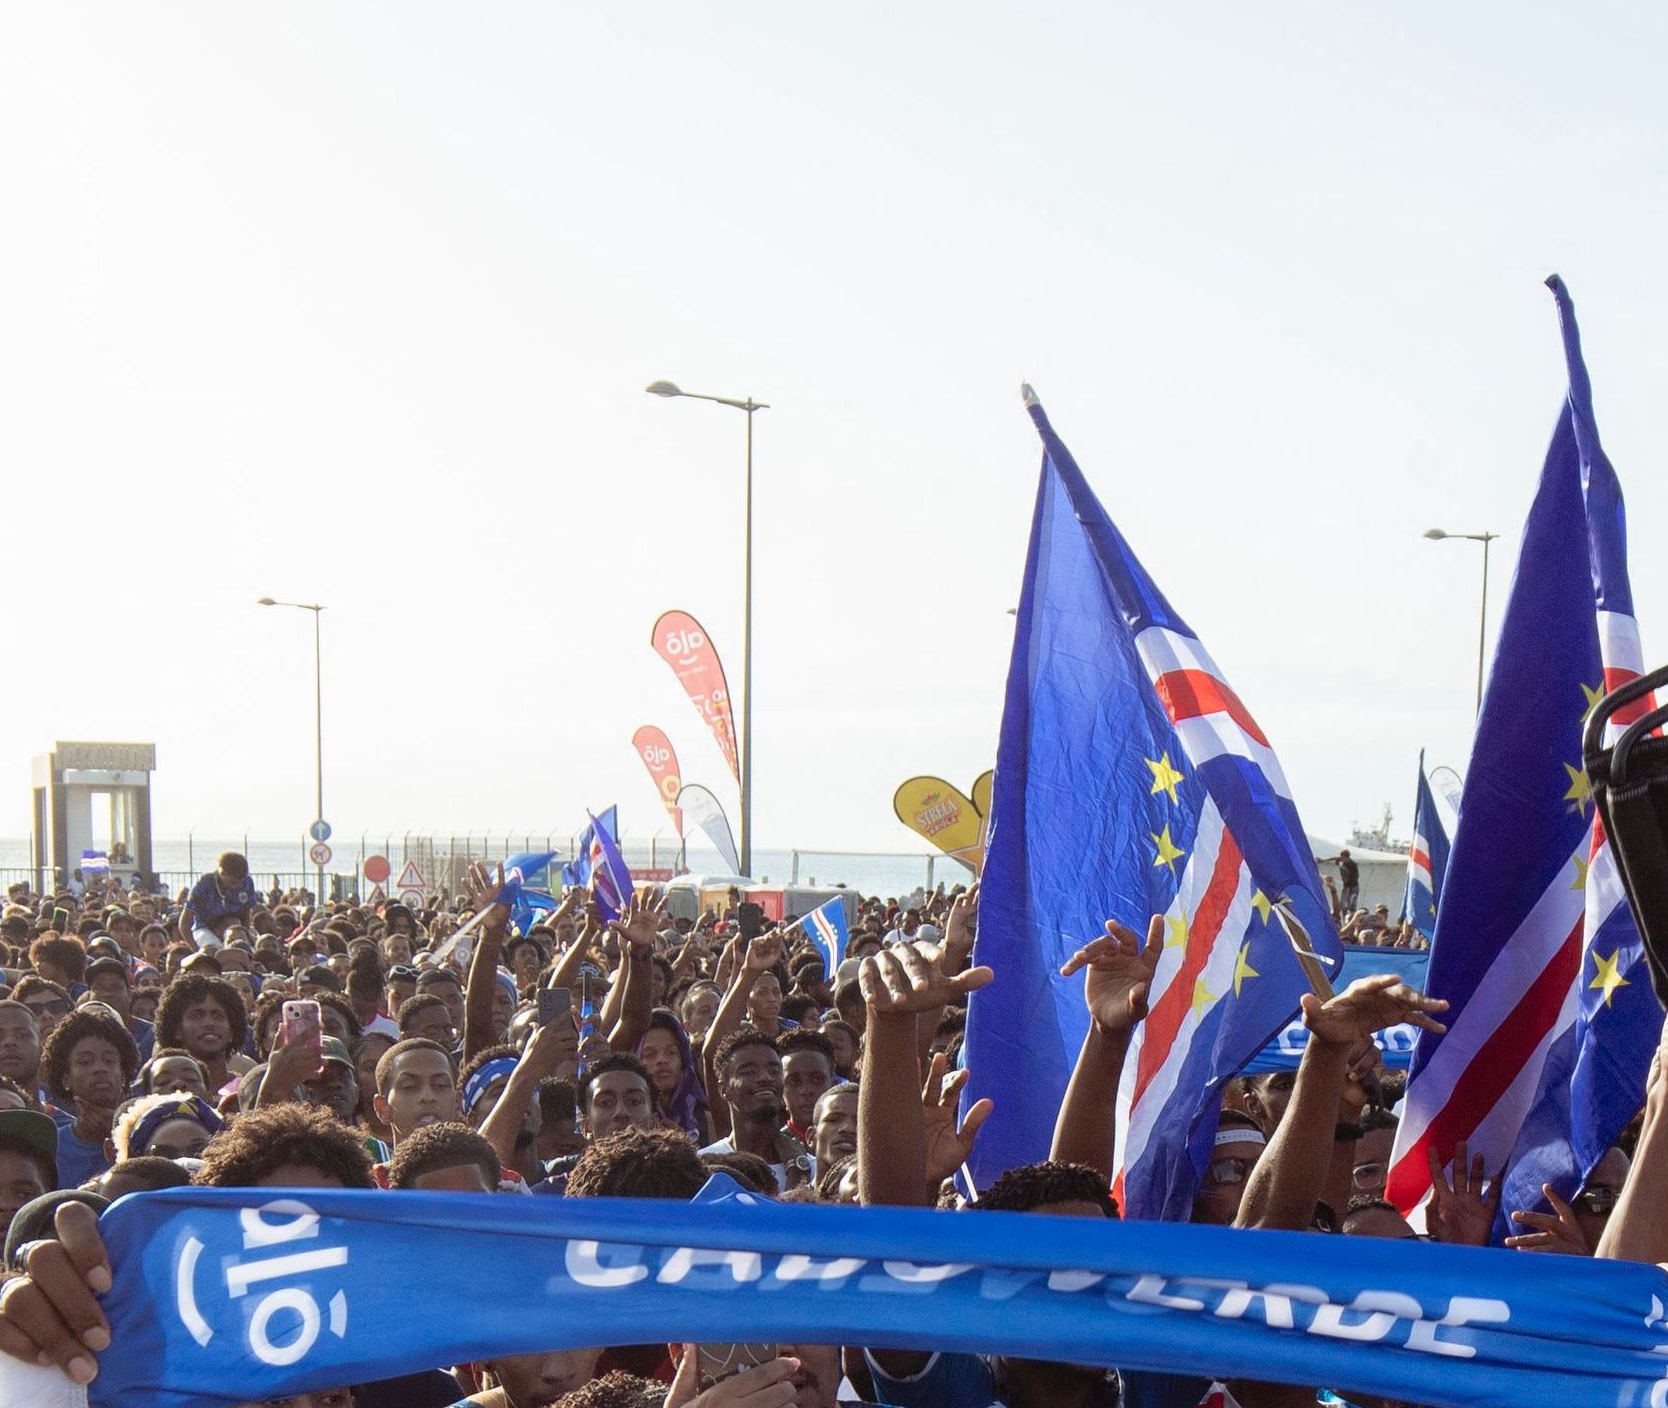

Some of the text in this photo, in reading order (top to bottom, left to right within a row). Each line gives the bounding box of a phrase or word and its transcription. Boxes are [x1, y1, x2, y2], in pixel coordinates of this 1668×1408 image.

[917, 798, 958, 828] STRELA
[565, 1240, 1510, 1358] CA ERDE
